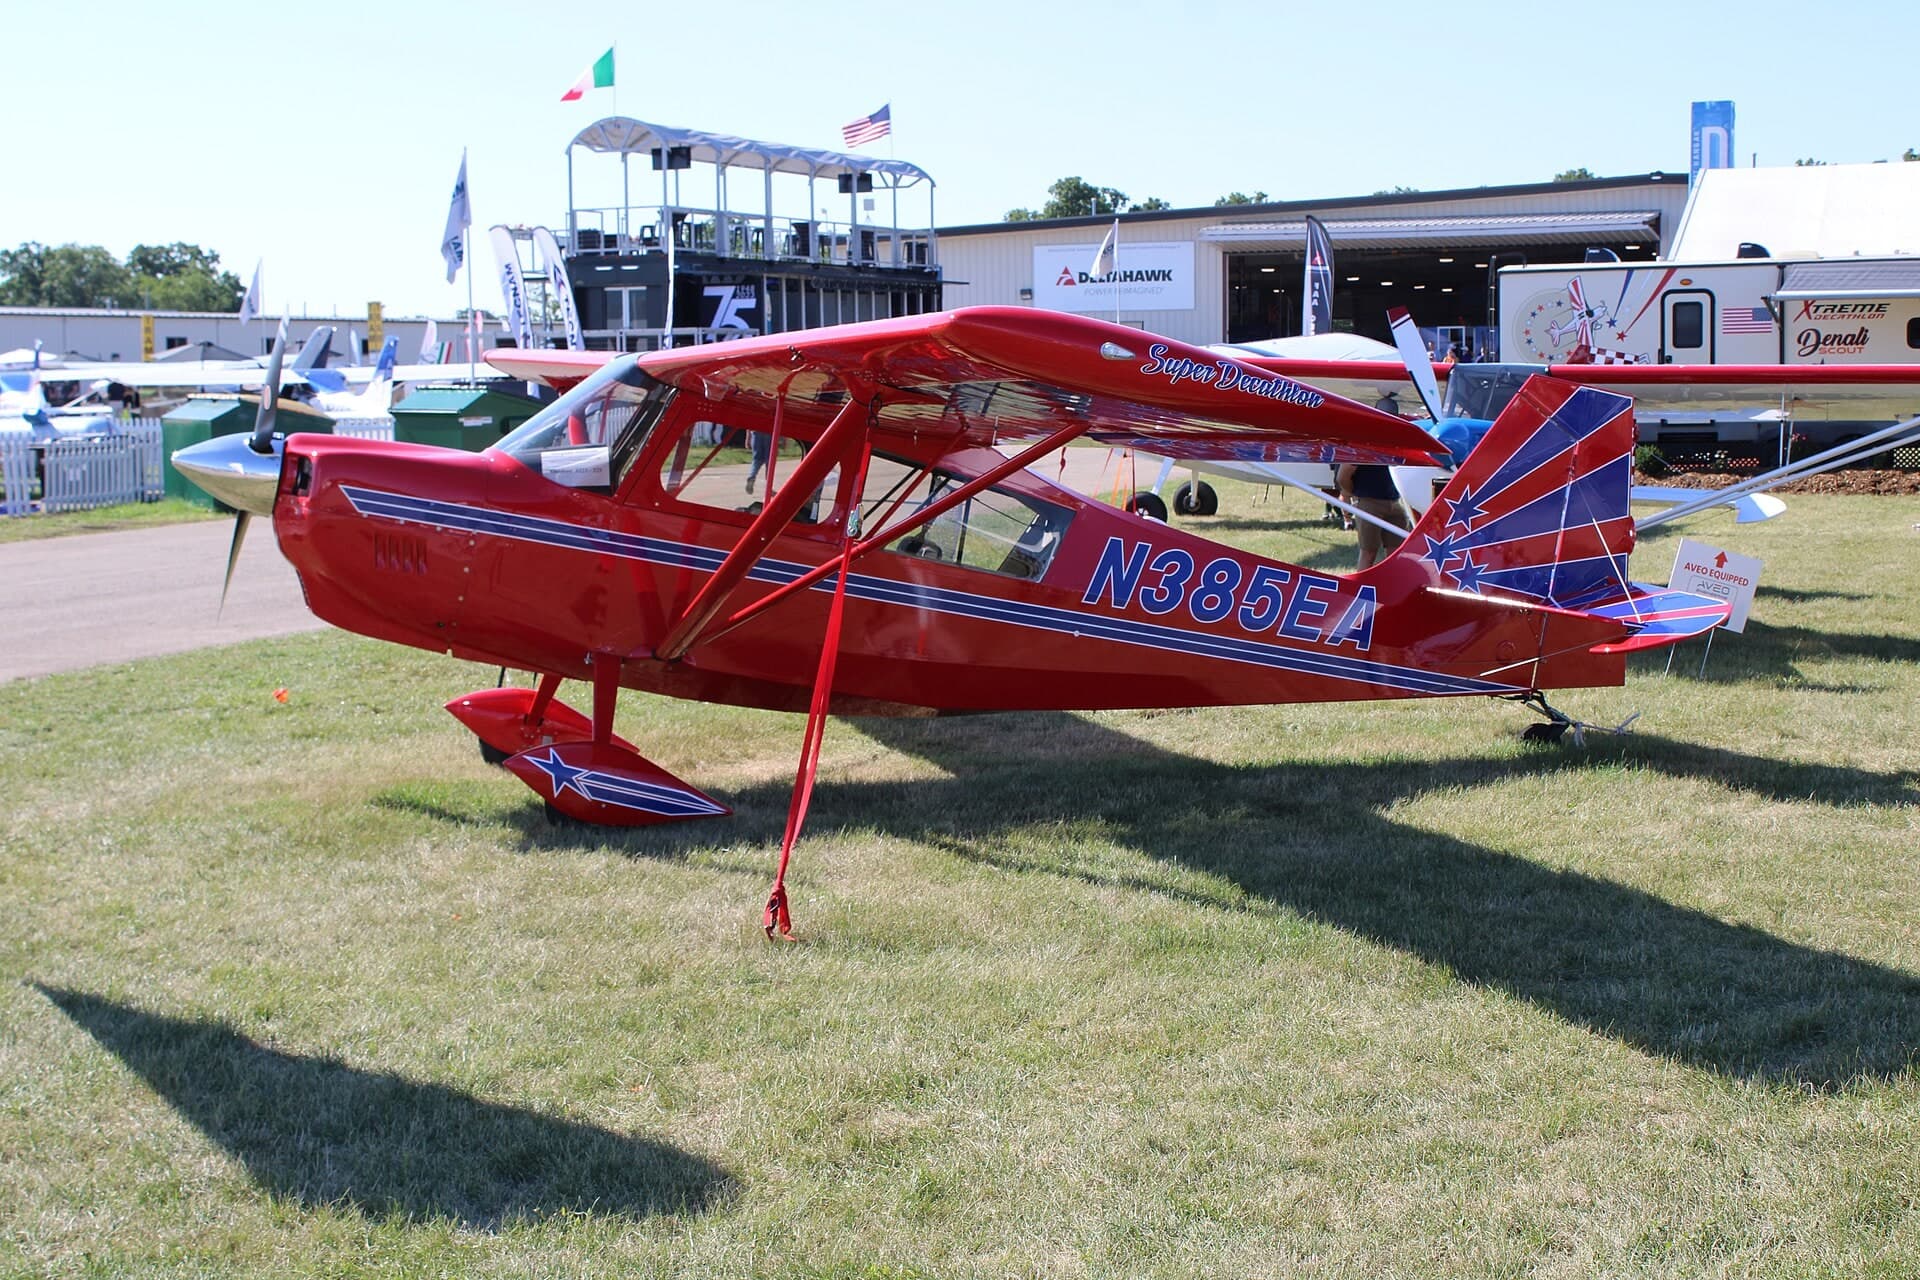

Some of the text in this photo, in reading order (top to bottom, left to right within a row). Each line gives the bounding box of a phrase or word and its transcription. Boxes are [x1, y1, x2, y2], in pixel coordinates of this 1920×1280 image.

[1797, 326, 1869, 357] Denali
[1141, 343, 1326, 409] Super Decathlon
[1684, 562, 1749, 586] AVEO EQUIPPED
[1697, 580, 1730, 595] AVEO
[1081, 536, 1377, 652] N385EA
